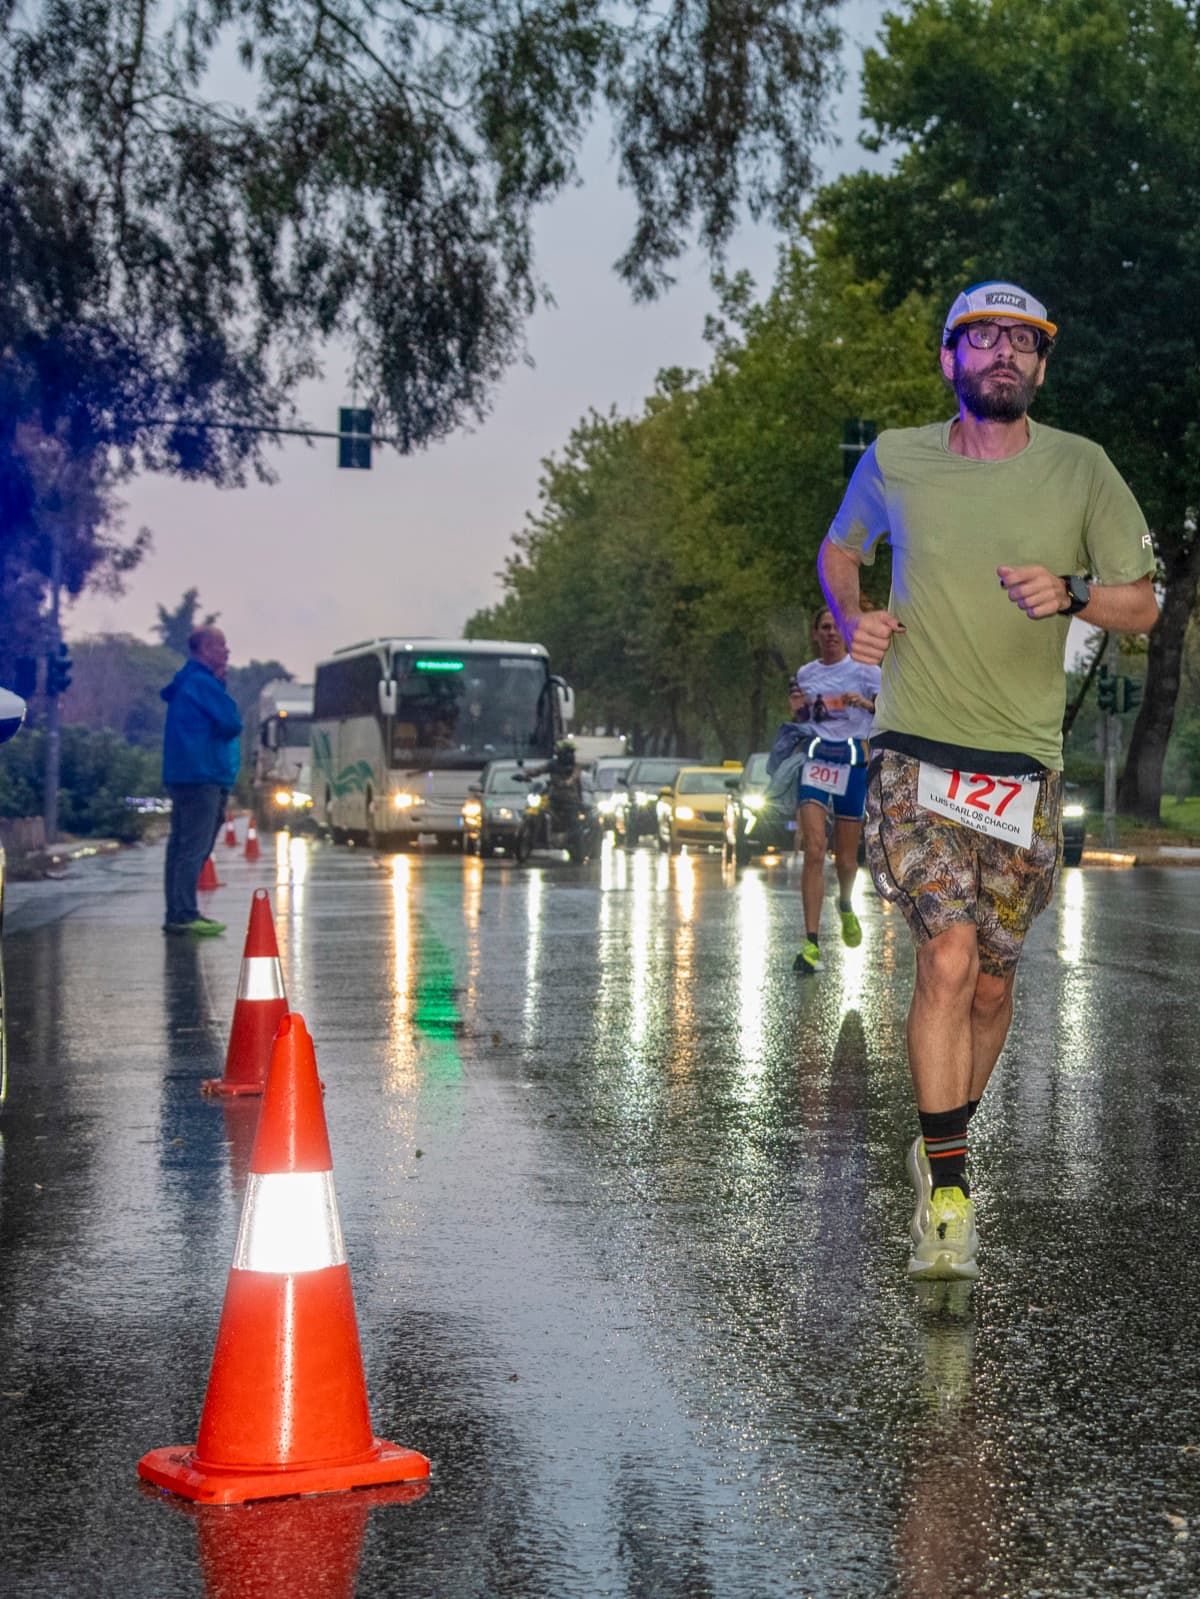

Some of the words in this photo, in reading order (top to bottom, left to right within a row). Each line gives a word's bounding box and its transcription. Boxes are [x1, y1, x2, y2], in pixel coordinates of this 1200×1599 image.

[809, 765, 839, 785] 201
[943, 769, 1022, 817] 127
[930, 793, 949, 807] LUIS
[949, 803, 984, 821] CARLOS
[984, 816, 1020, 834] CHACON
[960, 816, 988, 833] SALAS
